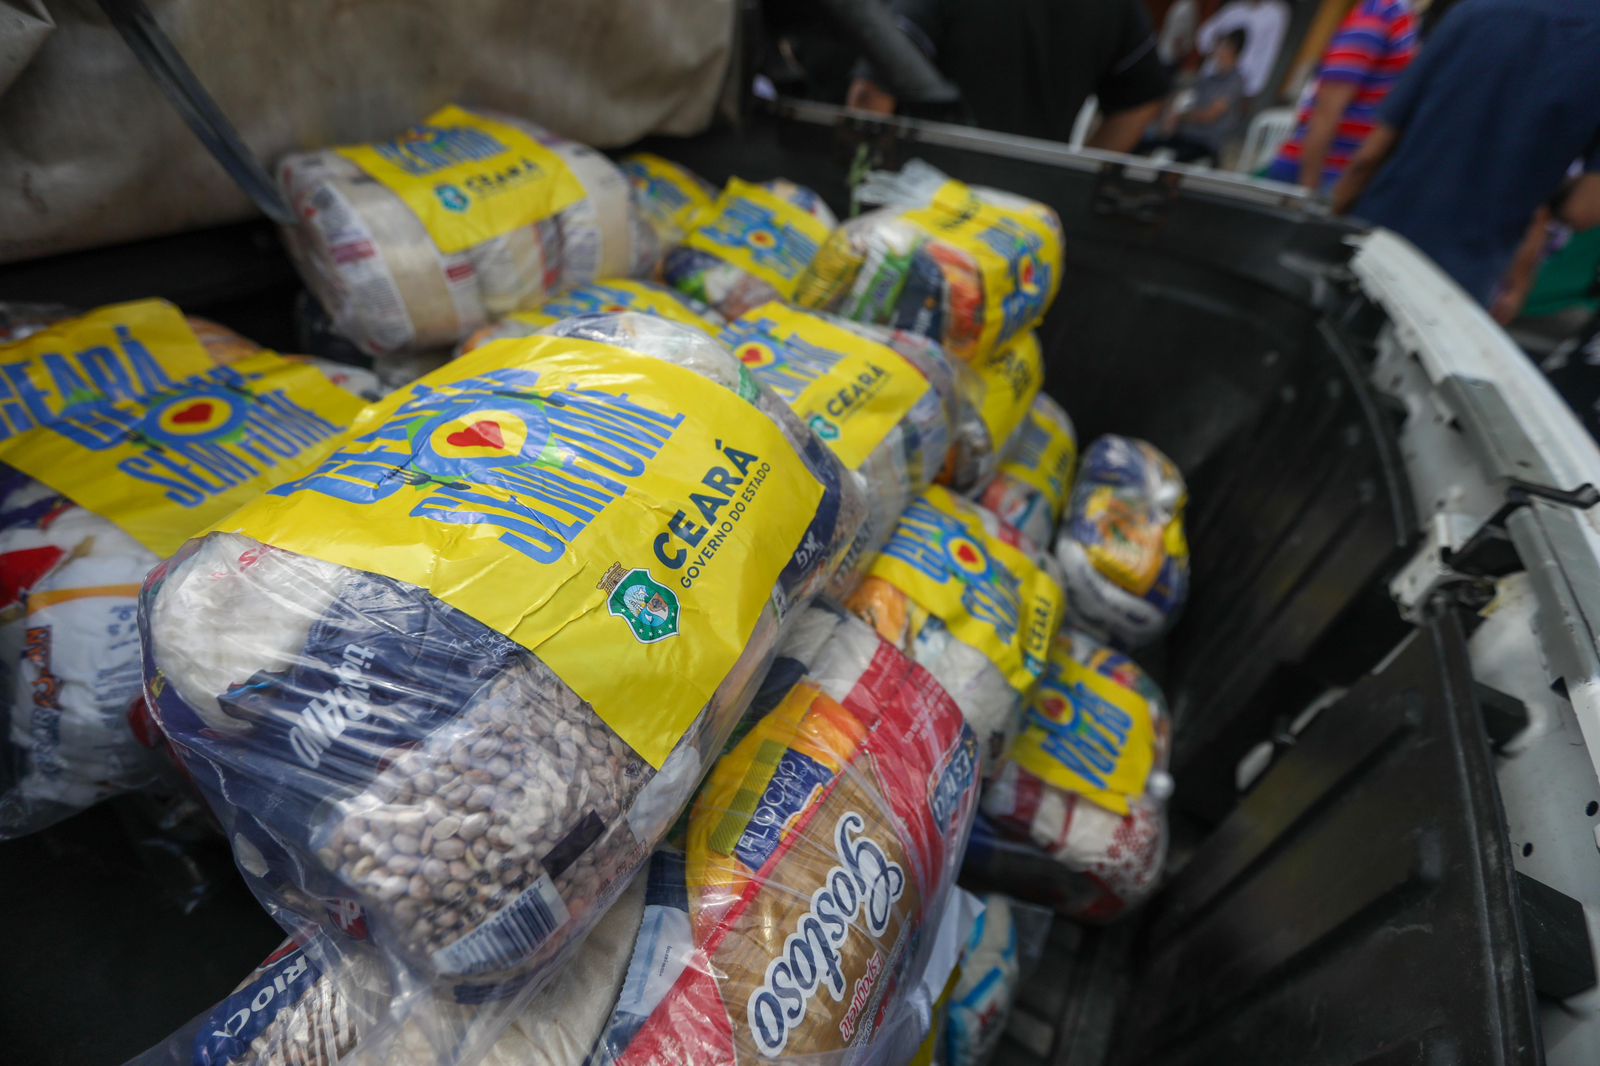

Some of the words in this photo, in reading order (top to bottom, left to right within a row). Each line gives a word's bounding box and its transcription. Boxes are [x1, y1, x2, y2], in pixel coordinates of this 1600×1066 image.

[116, 440, 261, 509] SEM
[238, 388, 349, 469] FOME
[825, 360, 887, 418] CEARÁ
[408, 463, 616, 566] SEM
[545, 383, 688, 498] FOME
[653, 438, 759, 570] CEARÁ
[680, 520, 735, 589] GOVERNO
[729, 501, 747, 522] DO
[740, 461, 772, 504] ESTADO
[749, 811, 904, 1056] Gostoso
